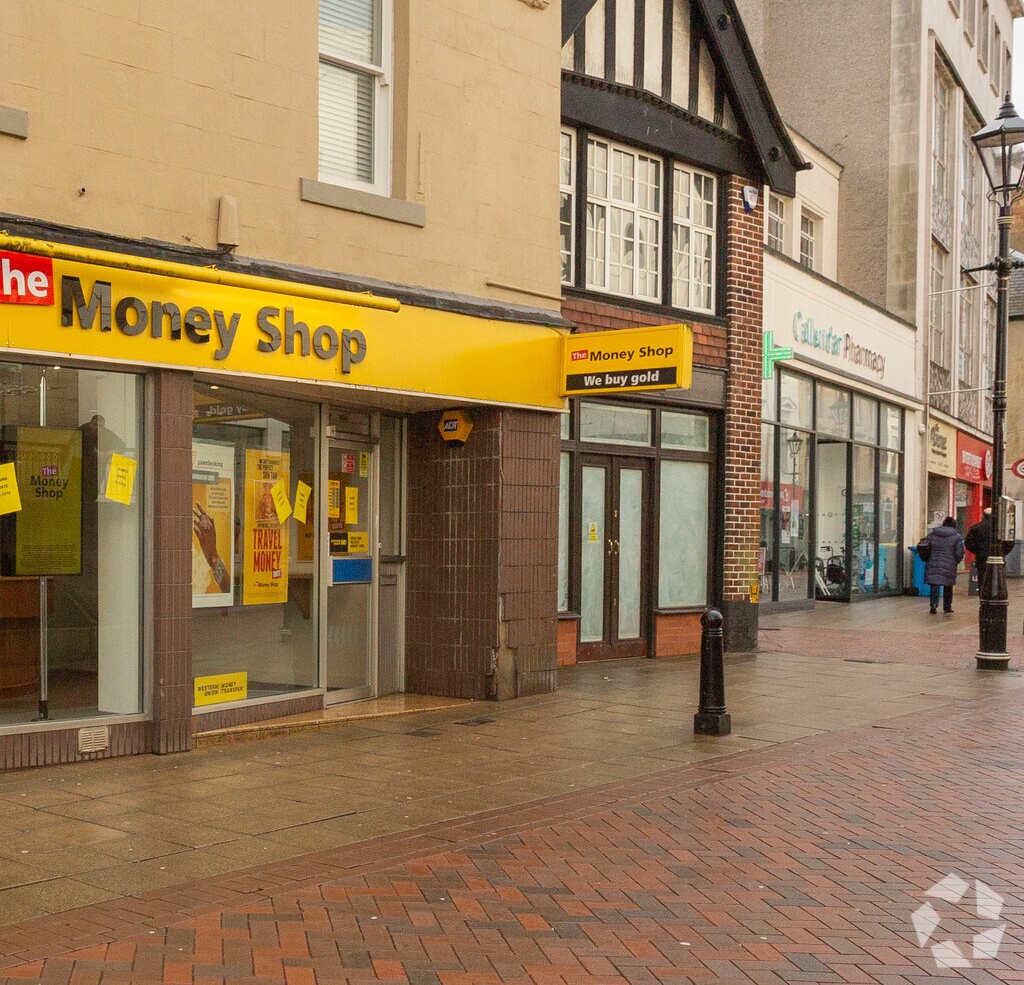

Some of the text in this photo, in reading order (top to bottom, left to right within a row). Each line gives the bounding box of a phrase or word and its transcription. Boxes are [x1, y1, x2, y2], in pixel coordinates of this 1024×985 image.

[60, 275, 241, 360] Money
[257, 305, 367, 374] Shop
[572, 346, 674, 362] The Money Shop
[843, 333, 886, 381] Pharmacy
[583, 370, 660, 387] We buy gold
[42, 467, 57, 476] The
[30, 475, 68, 490] Money
[34, 486, 63, 501] Shop
[252, 528, 282, 550] TRAVEL
[253, 551, 282, 573] MONEY
